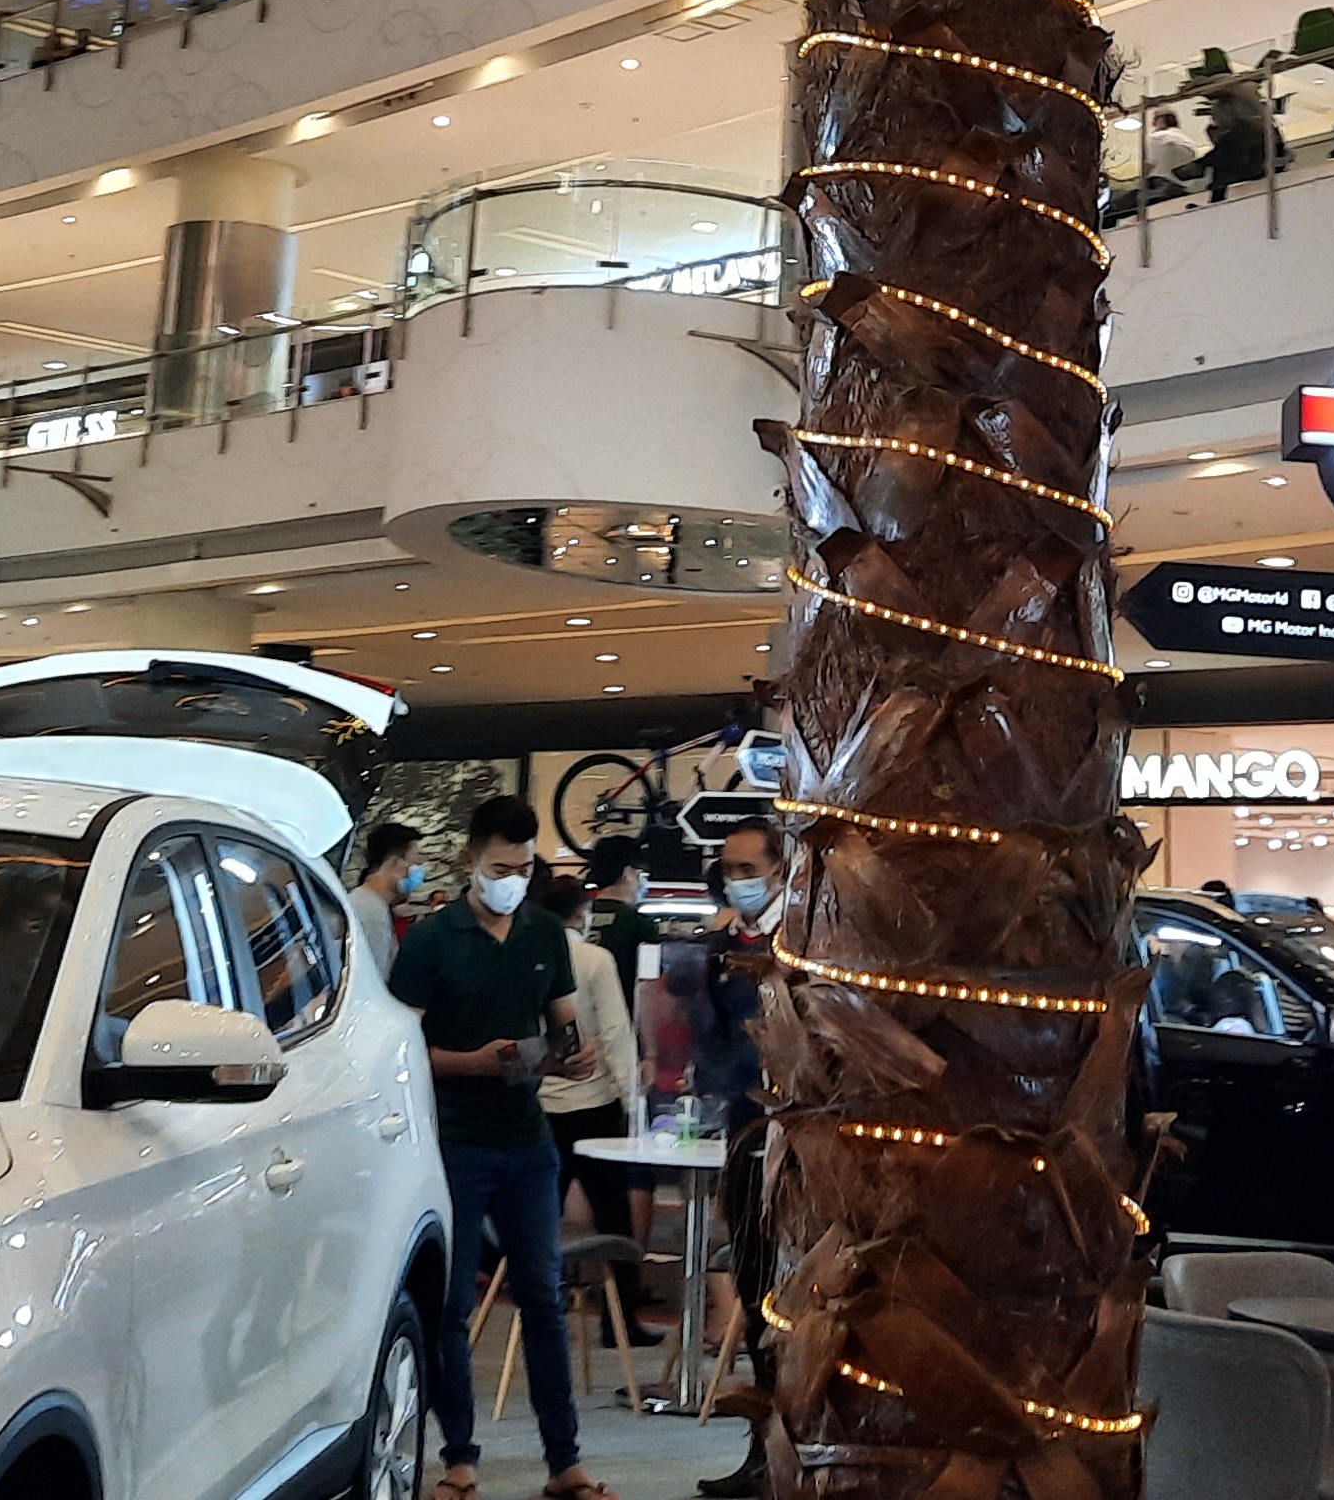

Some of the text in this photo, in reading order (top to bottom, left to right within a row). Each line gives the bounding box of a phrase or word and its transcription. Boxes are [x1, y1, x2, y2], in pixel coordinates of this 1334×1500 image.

[1247, 618, 1273, 634] MG
[1274, 620, 1317, 637] Motor
[1121, 749, 1321, 800] MANGO
